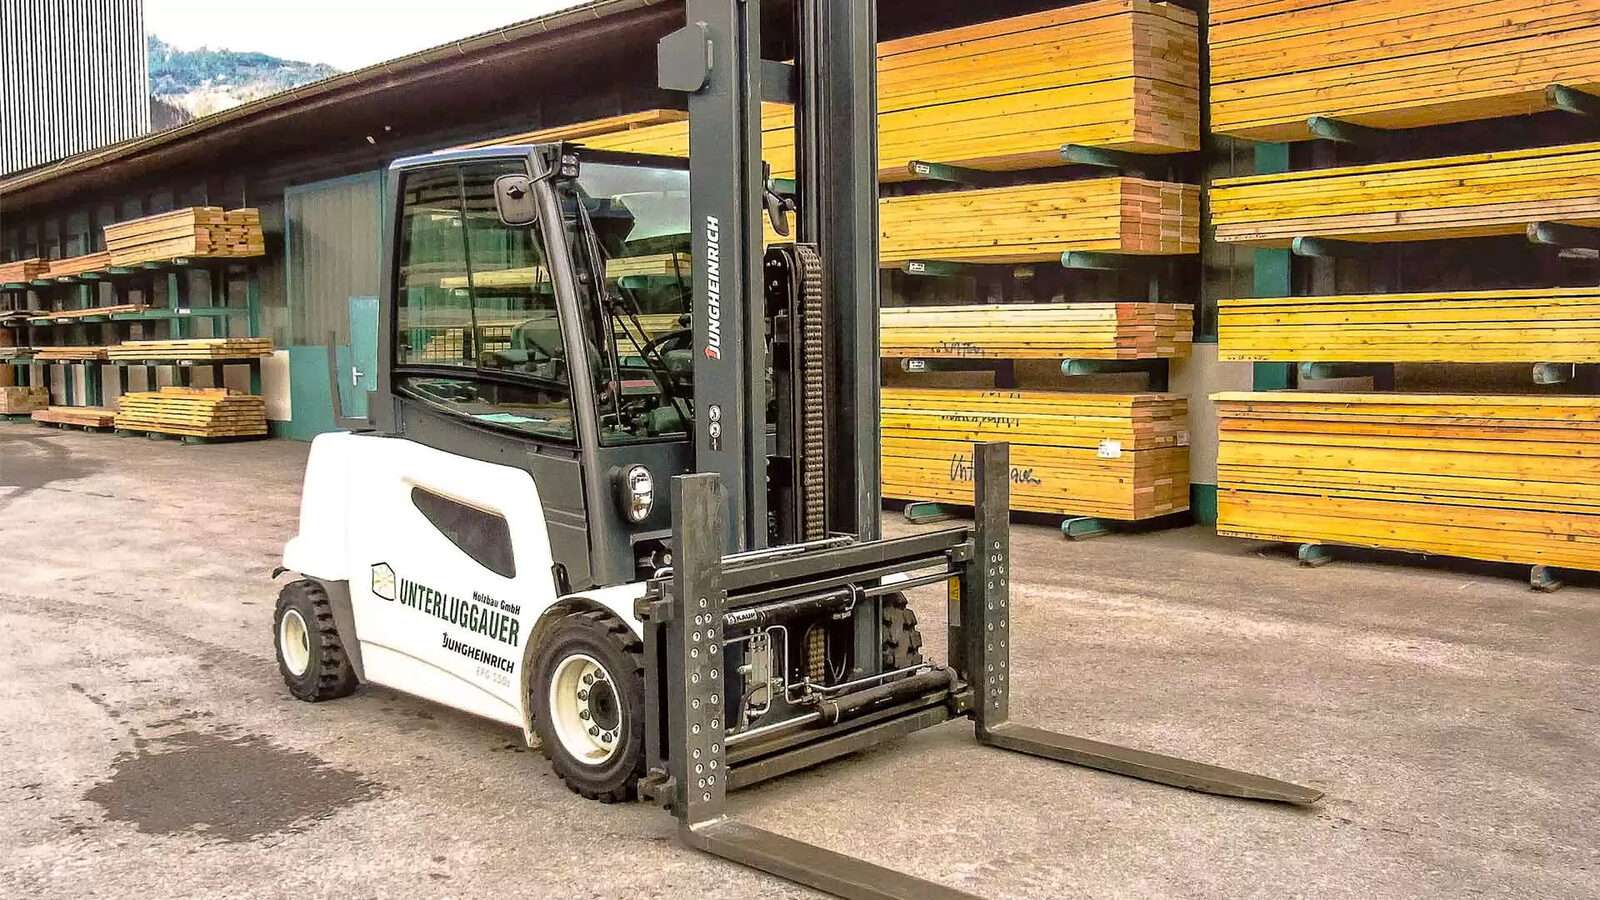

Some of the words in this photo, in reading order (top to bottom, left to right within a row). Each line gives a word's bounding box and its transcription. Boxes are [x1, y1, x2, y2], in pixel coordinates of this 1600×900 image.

[707, 215, 721, 360] JUNGHEINRICH
[400, 578, 519, 647] UNTERLUGGAUER
[473, 591, 499, 609] Holzbau
[500, 600, 521, 616] GmbH
[442, 632, 515, 674] JUNGHEINRICH
